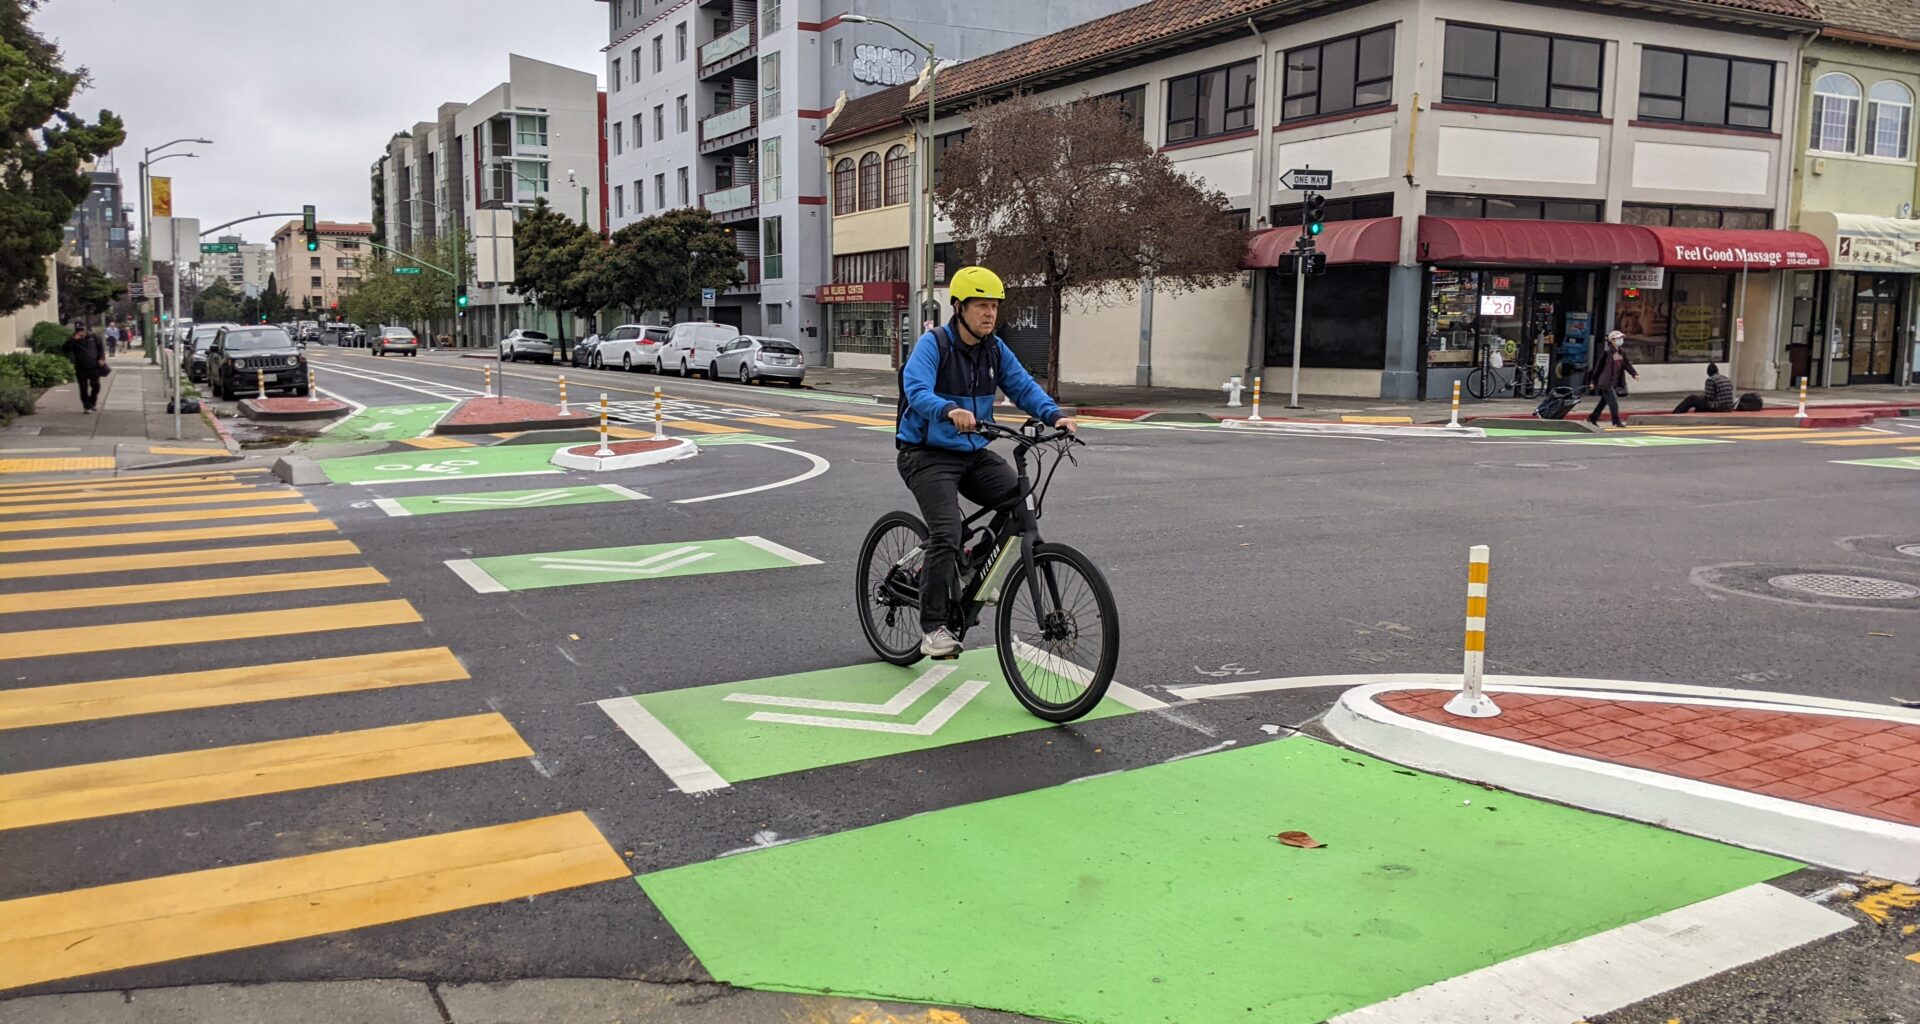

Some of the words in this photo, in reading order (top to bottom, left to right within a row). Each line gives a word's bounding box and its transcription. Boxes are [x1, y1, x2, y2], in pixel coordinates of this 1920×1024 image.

[1294, 176, 1309, 184] ONE
[1311, 176, 1325, 184] WAY
[1675, 246, 1701, 260] Feel
[1702, 247, 1733, 261] Good
[1734, 248, 1781, 266] Massage
[1620, 274, 1659, 282] MASSAGE
[980, 544, 1000, 580] AVENTON
